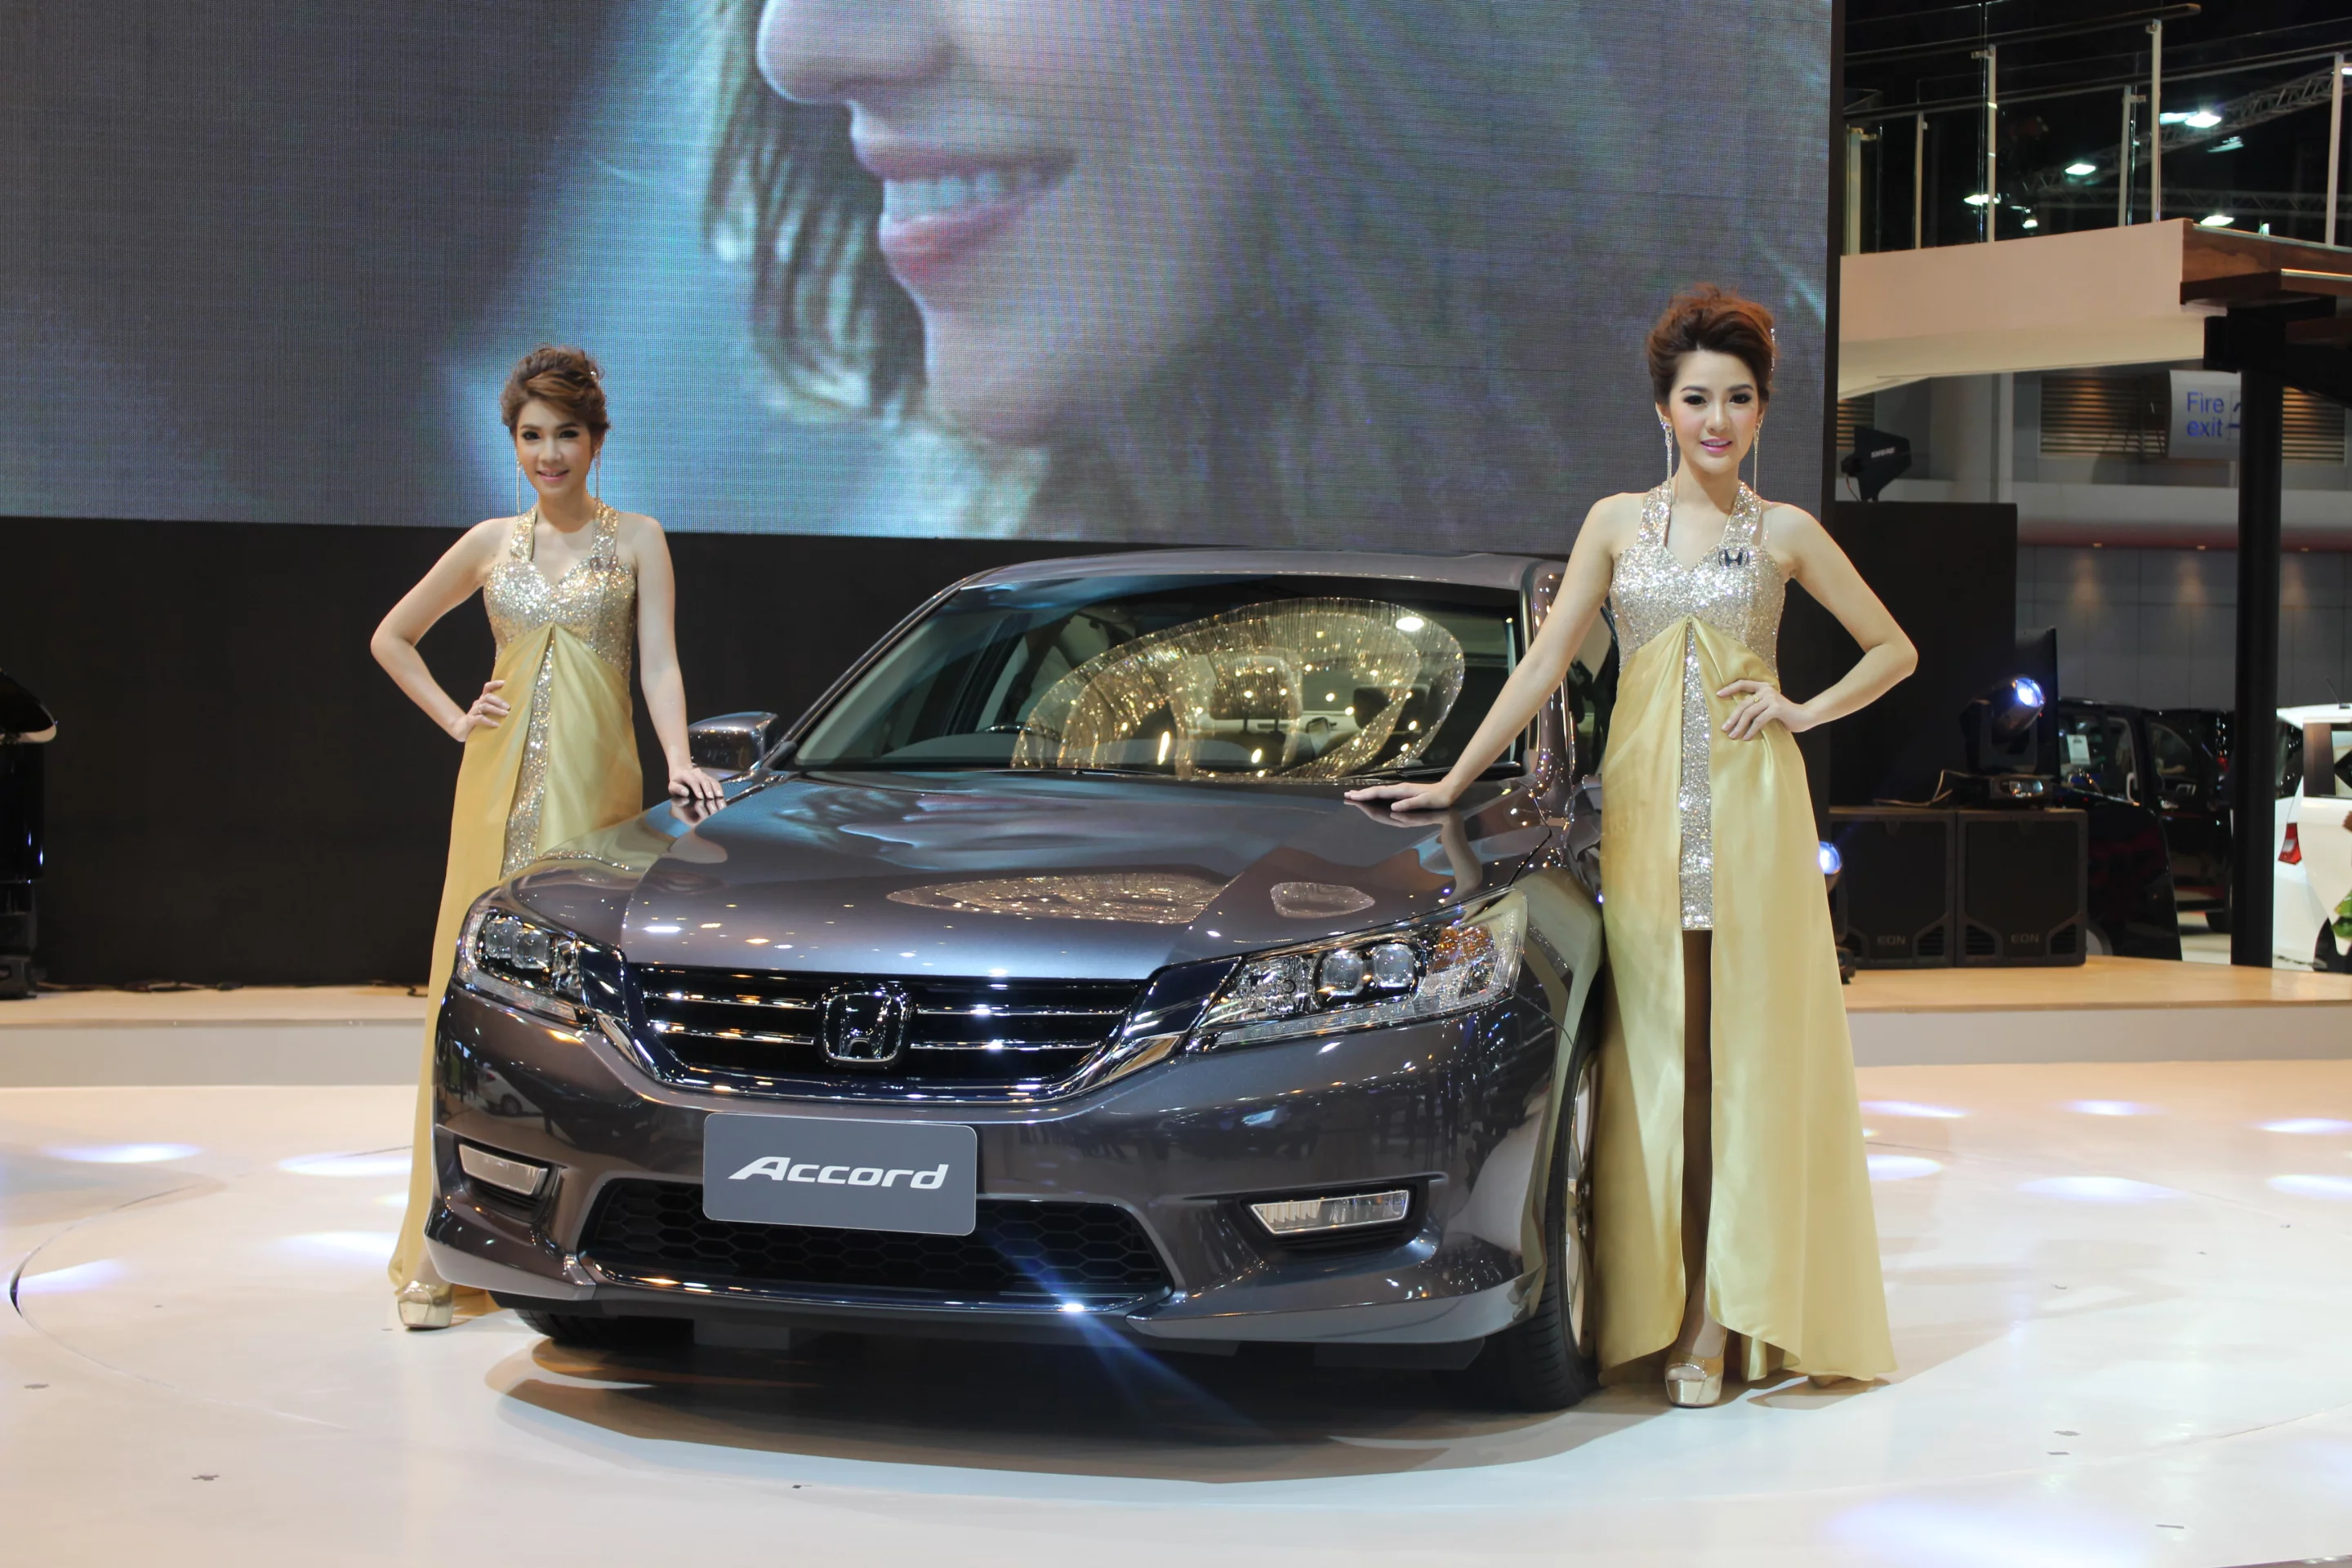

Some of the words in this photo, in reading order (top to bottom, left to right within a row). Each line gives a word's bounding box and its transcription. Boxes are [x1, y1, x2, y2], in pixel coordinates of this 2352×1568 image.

[2186, 391, 2225, 414] Fire
[2186, 416, 2223, 438] exit
[728, 1156, 950, 1190] Accord
